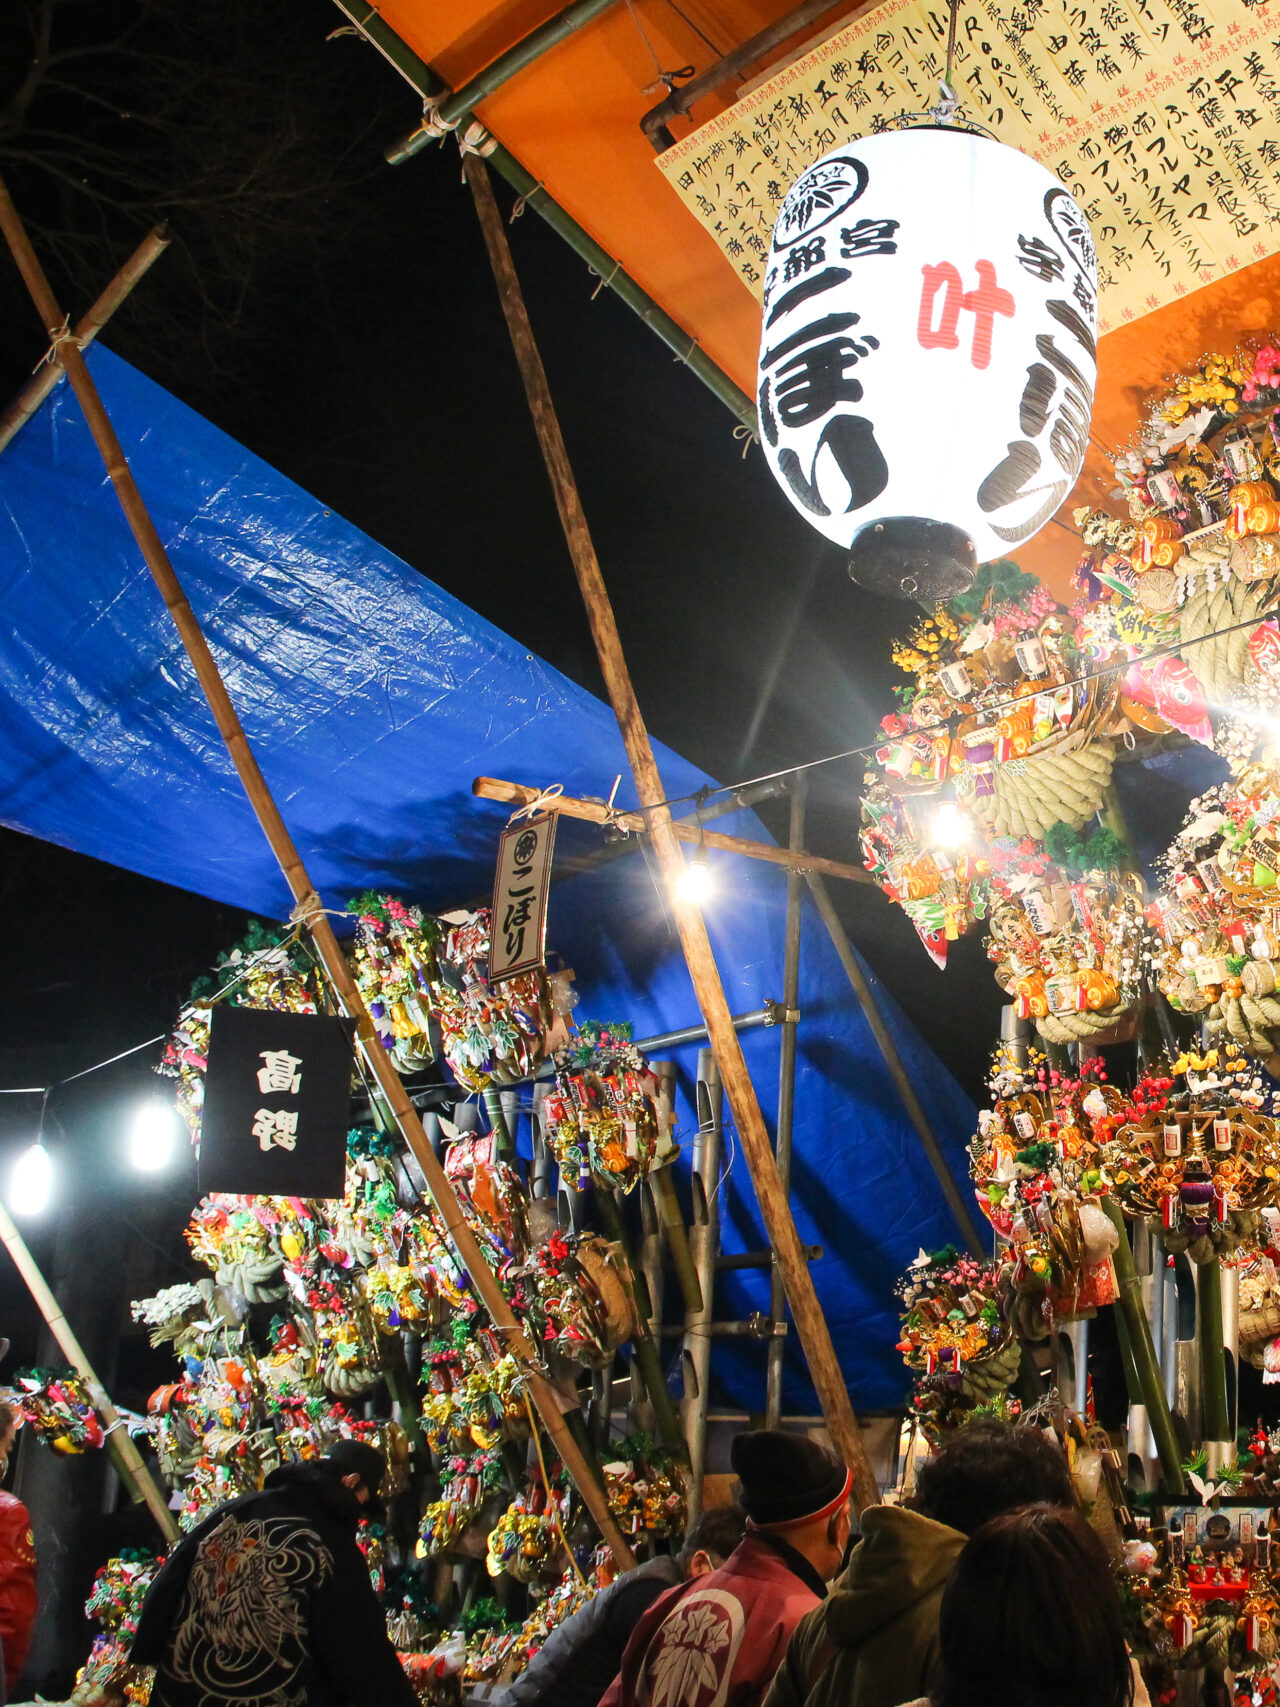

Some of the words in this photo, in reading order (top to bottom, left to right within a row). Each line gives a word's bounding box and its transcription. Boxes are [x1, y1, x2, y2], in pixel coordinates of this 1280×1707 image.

[1062, 0, 1122, 80] ラ設備
[1100, 0, 1143, 60] 総業
[787, 93, 837, 153] 新和
[813, 79, 863, 143] 五月
[727, 130, 787, 210] 第一建
[1055, 159, 1133, 271] ほのぼの亭
[917, 258, 1017, 371] 叶
[758, 266, 890, 517] こぼり
[504, 865, 537, 967] こぼり
